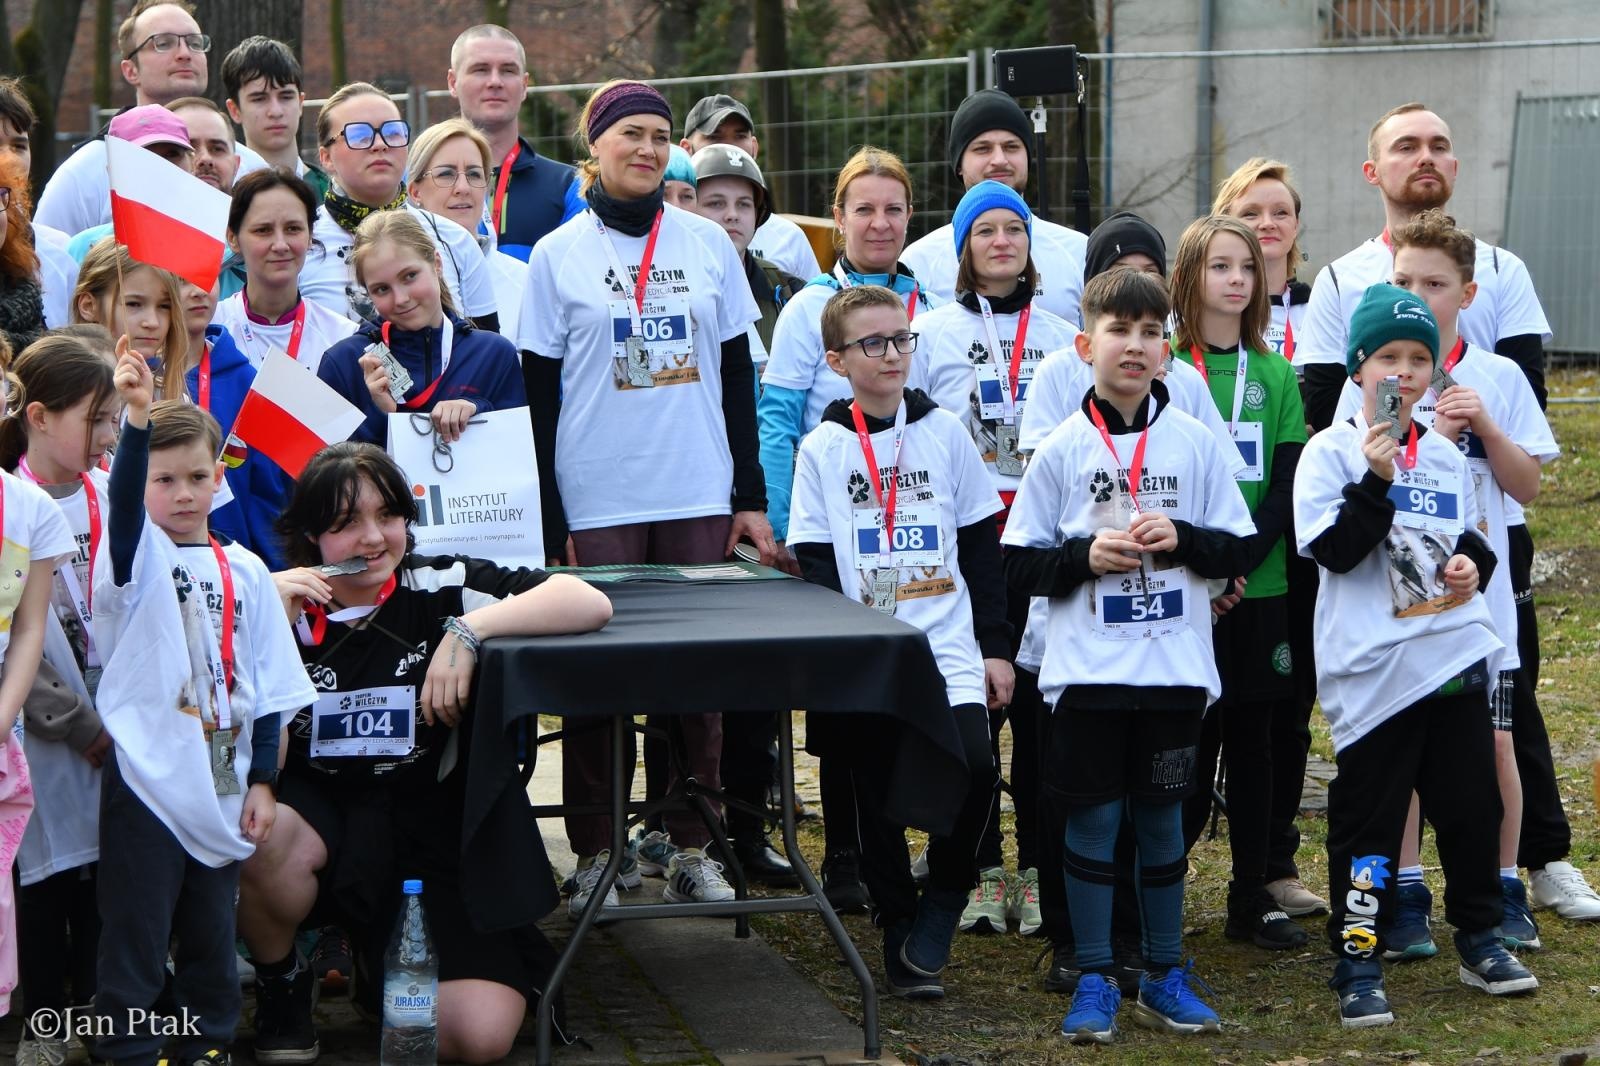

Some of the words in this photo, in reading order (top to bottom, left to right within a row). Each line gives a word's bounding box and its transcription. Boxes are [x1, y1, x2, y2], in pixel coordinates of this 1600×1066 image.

[630, 269, 686, 285] WLCZYM
[672, 285, 690, 294] 2026
[1119, 476, 1178, 493] WLCZYM
[448, 492, 507, 509] INSTYTUT
[1161, 498, 1178, 509] 2026
[1409, 488, 1438, 515] 96
[450, 508, 524, 525] LITERATURY
[1131, 595, 1165, 621] 54
[355, 696, 388, 708] WILCZYM
[340, 711, 394, 738] 104
[394, 996, 431, 1007] JURAJSKA
